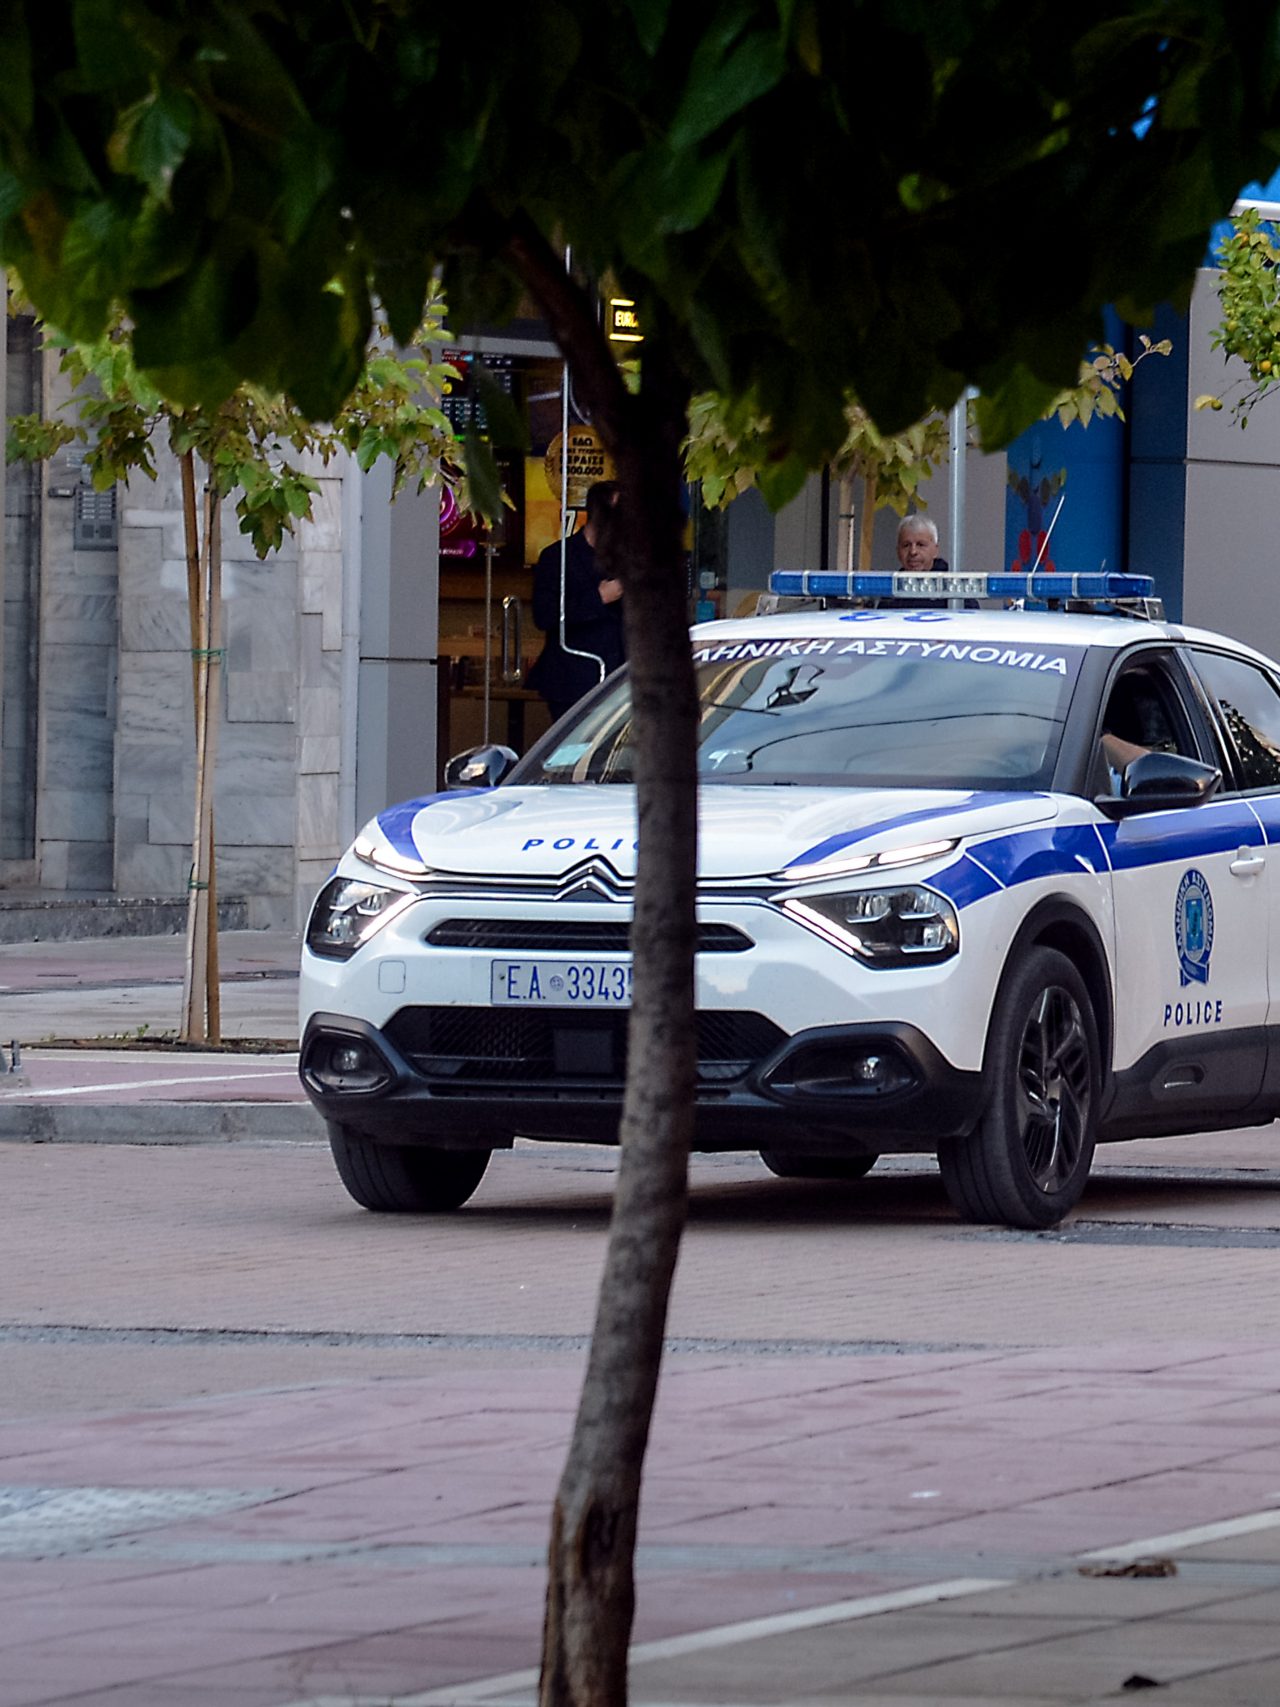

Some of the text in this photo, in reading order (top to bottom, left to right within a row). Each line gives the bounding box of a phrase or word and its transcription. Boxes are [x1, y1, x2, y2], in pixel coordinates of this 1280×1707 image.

[838, 639, 1068, 675] ΑΣΤΥΝΟΜΙΑ
[522, 838, 639, 851] POLI
[1163, 1000, 1223, 1027] POLICE
